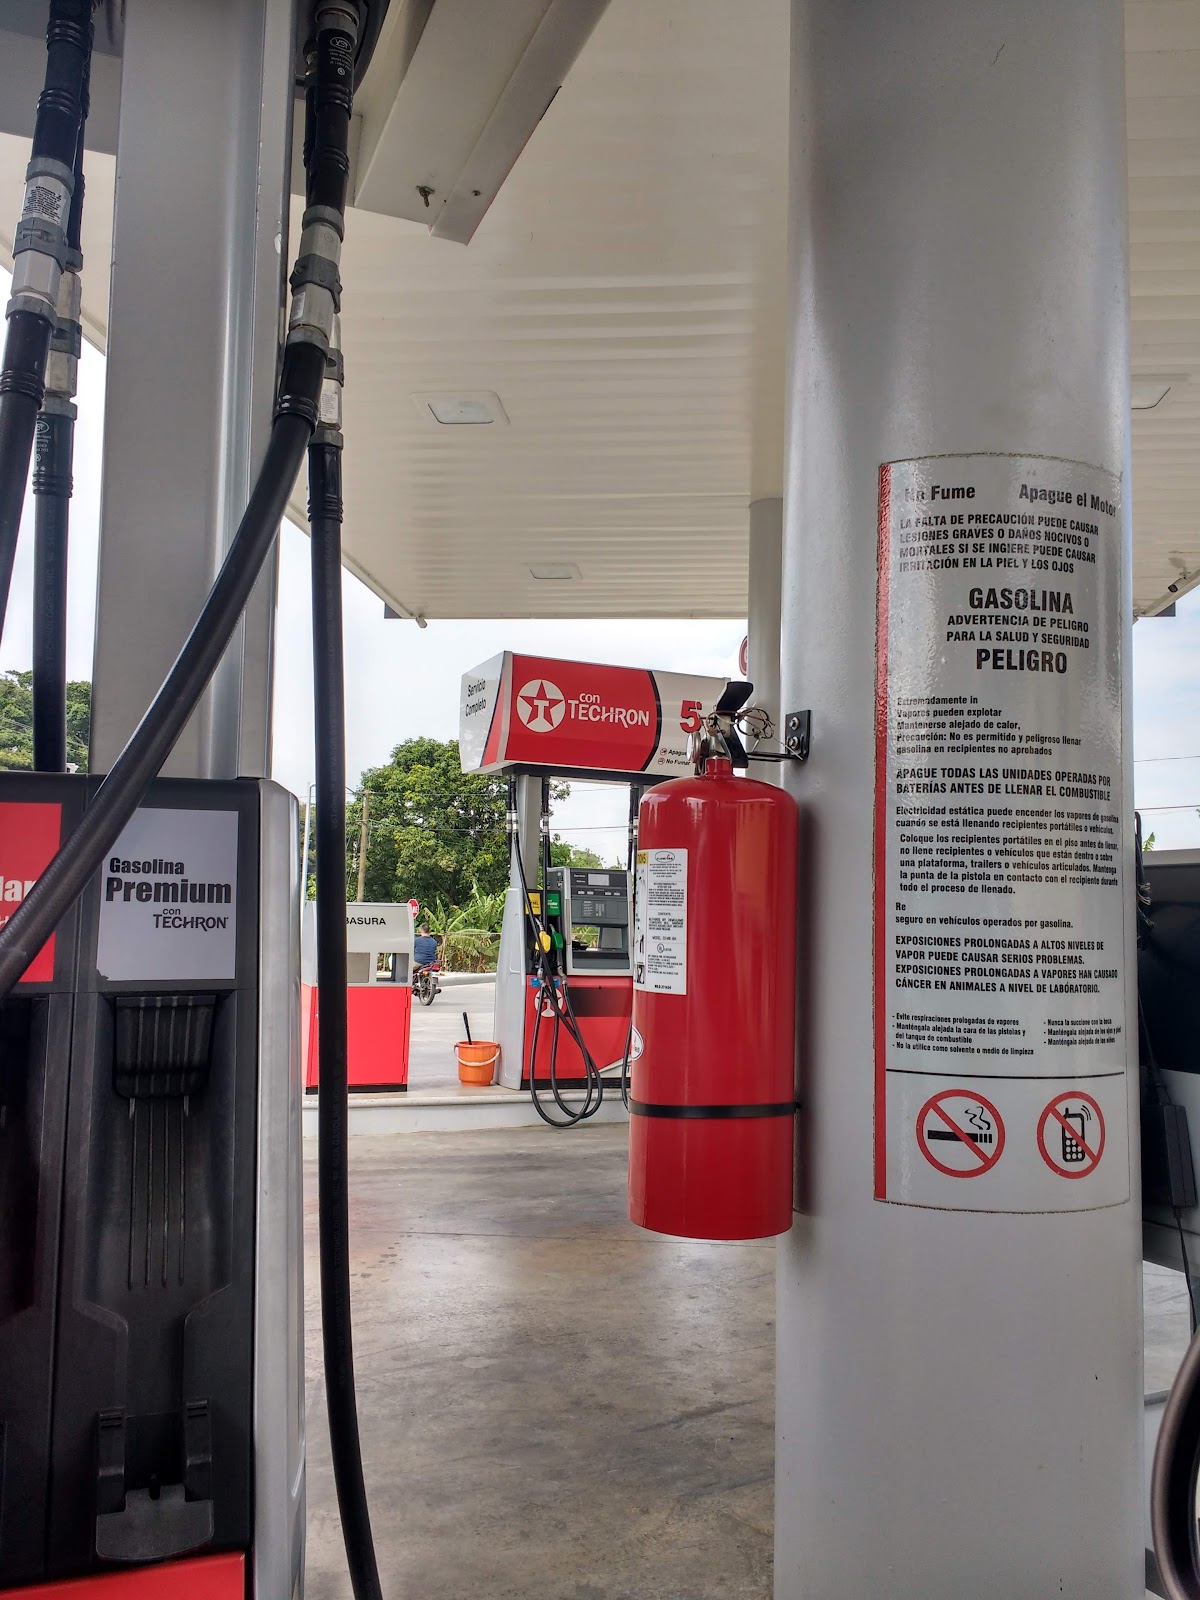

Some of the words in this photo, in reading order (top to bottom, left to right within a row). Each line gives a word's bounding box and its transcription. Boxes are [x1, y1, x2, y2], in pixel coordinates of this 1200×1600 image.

[931, 485, 976, 501] Fume
[1019, 483, 1073, 509] Apague
[1076, 491, 1088, 507] el
[1090, 495, 1117, 518] Motor
[900, 517, 912, 530] LA
[915, 515, 947, 528] FALTA
[950, 514, 964, 525] DE
[968, 512, 1036, 526] PRECAUCIÓN
[1038, 516, 1068, 530] PUEDE
[1069, 519, 1099, 535] CAUSAR
[901, 529, 950, 543] LESIONES
[952, 529, 995, 540] GRAVES
[1008, 527, 1042, 541] DAÑOS
[1044, 529, 1083, 547] NOCIVOS
[900, 544, 955, 558] MORTALES
[958, 543, 969, 554] SI
[972, 543, 985, 554] SE
[989, 543, 1030, 555] INGIERE
[1033, 545, 1063, 558] PUEDE
[1065, 549, 1096, 563] CAUSAR
[900, 557, 960, 573] IRRITACIÓN
[962, 558, 977, 569] EN
[980, 557, 993, 568] LA
[996, 557, 1020, 569] PIEL
[1031, 560, 1049, 572] LOS
[1051, 561, 1075, 574] OJOS
[968, 588, 1074, 615] GASOLINA
[947, 615, 1030, 627] ADVERTENCIA
[1032, 616, 1047, 629] DE
[1050, 618, 1090, 633] PELIGRO
[946, 631, 976, 642] PARA
[979, 631, 993, 642] LA
[995, 632, 1030, 643] SALUD
[1041, 633, 1090, 649] SEGURIDAD
[976, 648, 1068, 674] PELIGRO
[468, 677, 486, 698] Servicio
[579, 693, 600, 704] con
[897, 696, 968, 706] Extremadamente
[466, 697, 487, 717] Completo
[568, 699, 650, 729] TECHRON
[897, 708, 931, 721] Vapores
[932, 708, 965, 719] pueden
[967, 708, 1002, 718] explotar
[680, 699, 703, 733] 5
[896, 720, 947, 731] Mantenerse
[949, 720, 982, 731] alejado
[996, 720, 1021, 732] calor,
[896, 732, 947, 742] Precaución:
[949, 732, 961, 741] No
[976, 732, 1016, 744] permitido
[1025, 733, 1061, 746] peligroso
[1062, 735, 1082, 746] llenar
[896, 745, 932, 756] gasolina
[947, 745, 996, 755] recipientes
[1011, 745, 1053, 757] aprobados
[896, 768, 938, 779] APAGUE
[941, 767, 976, 779] TODAS
[979, 768, 999, 780] LAS
[1002, 769, 1053, 783] UNIDADES
[1055, 772, 1097, 786] OPERADAS
[1099, 775, 1111, 787] POR
[896, 782, 947, 794] BATERÍAS
[950, 783, 985, 794] ANTES
[988, 784, 1002, 795] DE
[1005, 784, 1043, 796] LLENAR
[1046, 786, 1057, 797] EL
[1059, 787, 1111, 802] COMBUSTIBLE
[896, 806, 947, 816] Electricidad
[949, 807, 985, 816] estática
[987, 807, 1014, 819] puede
[1015, 808, 1052, 819] encender
[1054, 810, 1065, 820] los
[1067, 812, 1092, 823] vapores
[1100, 813, 1119, 825] gasolina
[895, 819, 926, 828] cuando
[941, 819, 960, 829] está
[963, 819, 1000, 829] llenando
[1002, 820, 1048, 832] recipientes
[1050, 822, 1083, 834] portátiles
[900, 834, 934, 845] Coloque
[936, 834, 949, 844] los
[951, 834, 1001, 846] recipientes
[1002, 836, 1042, 848] portátiles
[1064, 838, 1079, 850] piso
[1080, 839, 1097, 849] antes
[913, 846, 934, 856] llene
[936, 847, 985, 858] recipientes
[995, 847, 1035, 858] vehículos
[1036, 850, 1051, 860] que
[1052, 849, 1073, 860] están
[1074, 851, 1094, 861] dentro
[1100, 852, 1114, 862] sobre
[109, 857, 185, 875] Gasolina
[900, 860, 916, 868] una
[918, 859, 968, 871] plataforma,
[971, 859, 1002, 870] trailers
[1013, 860, 1050, 871] vehículos
[1052, 862, 1092, 873] articulados.
[1093, 864, 1117, 876] Mantenga
[910, 871, 935, 882] punta
[961, 871, 991, 883] pistola
[1006, 873, 1043, 883] contacto
[1045, 876, 1059, 884] con
[1069, 875, 1100, 887] recipiente
[1101, 877, 1119, 887] durante
[105, 877, 232, 904] Premium
[900, 883, 919, 892] todo
[931, 885, 966, 895] proceso
[981, 884, 1017, 894] llenado.
[162, 908, 181, 916] con
[895, 902, 907, 911] Re
[153, 914, 229, 932] TECHRON
[895, 916, 924, 926] seguro
[939, 916, 981, 926] vehículos
[982, 917, 1023, 929] operados
[1024, 920, 1038, 929] por
[1040, 918, 1074, 930] gasolina.
[895, 935, 962, 948] EXPOSICIONES
[964, 938, 1031, 950] PROLONGADAS
[1040, 939, 1066, 950] ALTOS
[1067, 940, 1096, 950] NIVELES
[1096, 940, 1105, 950] DE
[896, 950, 925, 961] VAPOR
[928, 951, 959, 962] PUEDE
[961, 952, 999, 963] CAUSAR
[1002, 953, 1034, 964] SERIOS
[1036, 953, 1085, 965] PROBLEMAS.
[895, 964, 962, 977] EXPOSICIONES
[964, 967, 1031, 979] PROLONGADAS
[1041, 969, 1077, 979] VAPORES
[1078, 969, 1093, 979] HAN
[1093, 969, 1118, 979] CAUSADO
[895, 977, 932, 990] CÁNCER
[934, 980, 947, 990] EN
[949, 980, 997, 992] ANIMALES
[1008, 982, 1034, 993] NIVEL
[1036, 983, 1047, 993] DE
[896, 1013, 910, 1021] Evite
[996, 1018, 1020, 1028] vapores
[936, 1034, 973, 1044] combustible
[998, 1027, 1021, 1038] pistolas
[1011, 1047, 1034, 1058] limpieza
